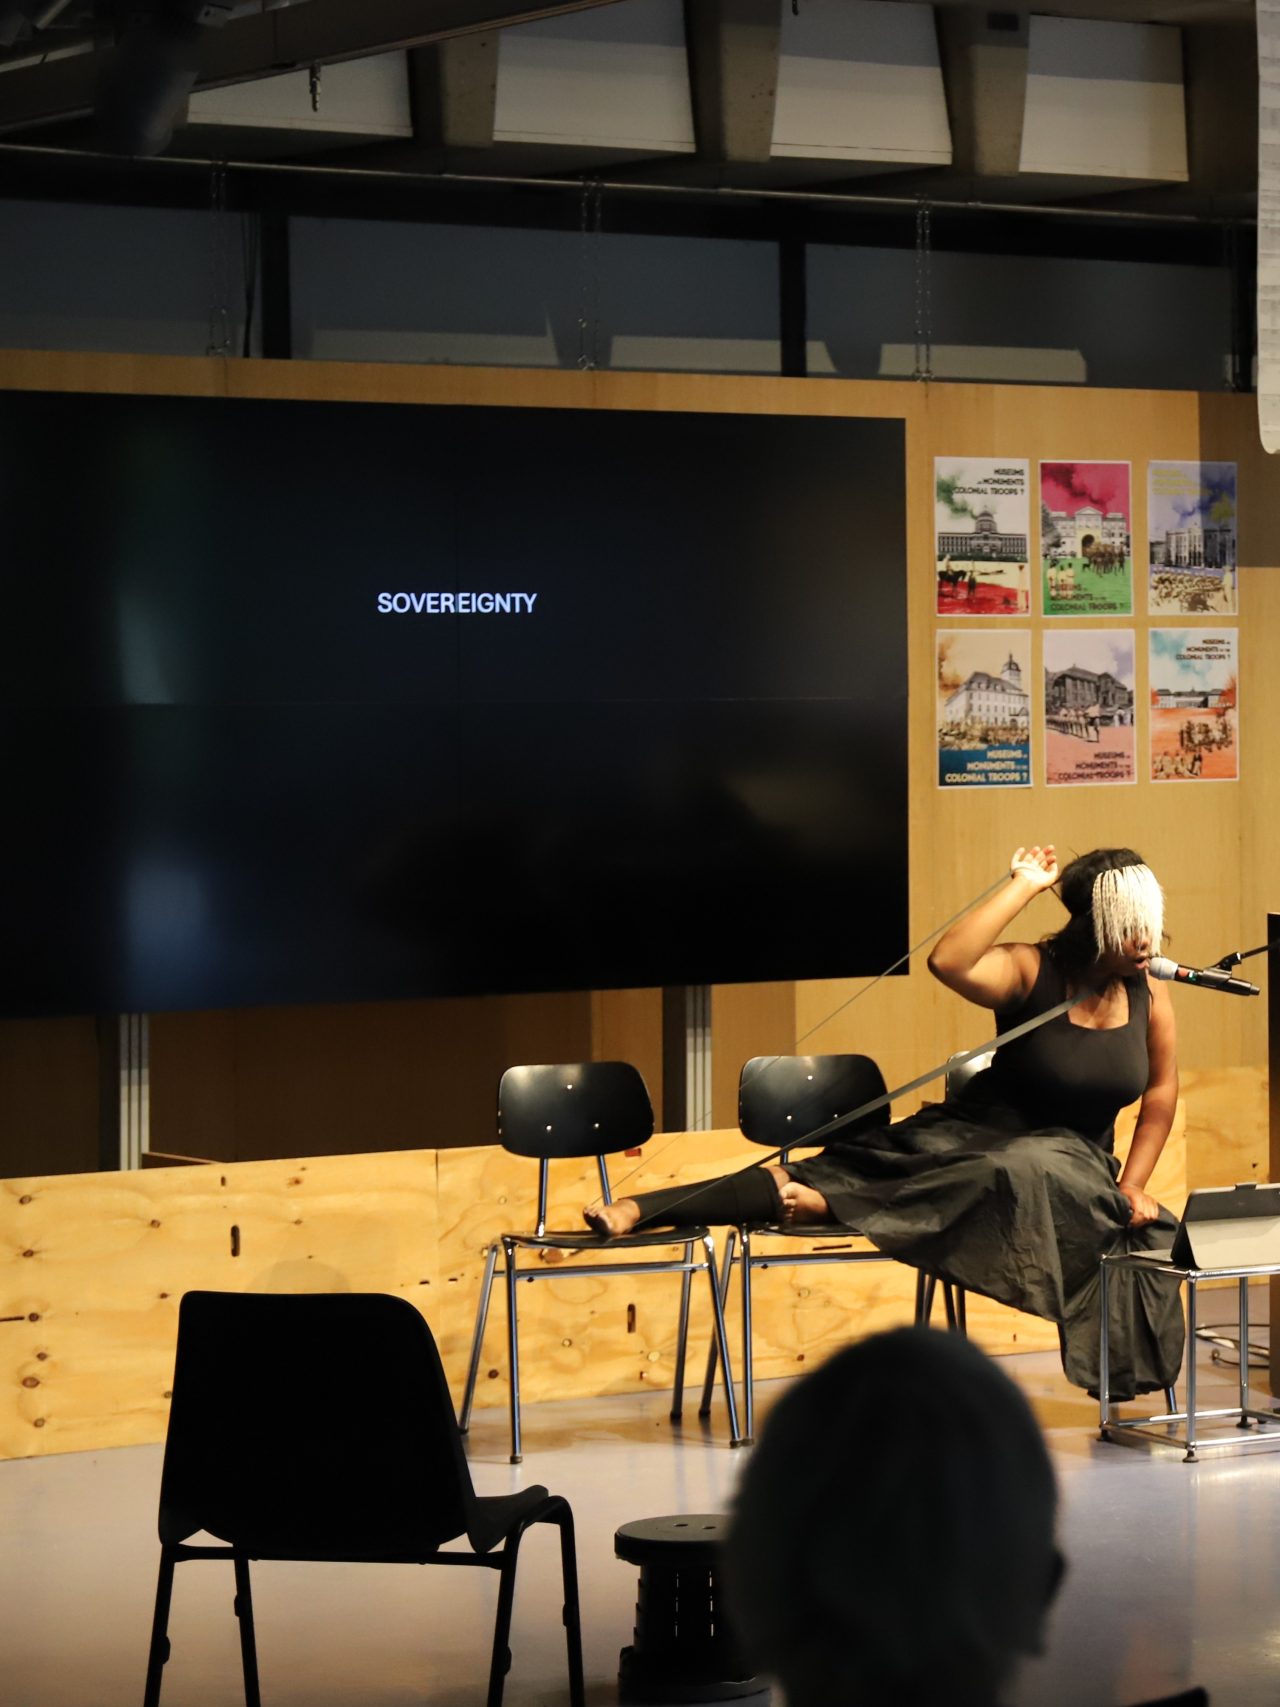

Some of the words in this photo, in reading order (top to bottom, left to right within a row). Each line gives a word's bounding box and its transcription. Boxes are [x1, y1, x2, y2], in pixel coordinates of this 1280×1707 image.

[377, 592, 538, 614] SOVEREIGNTY
[945, 772, 987, 783] COLONIAL
[988, 771, 1021, 782] TROOPS
